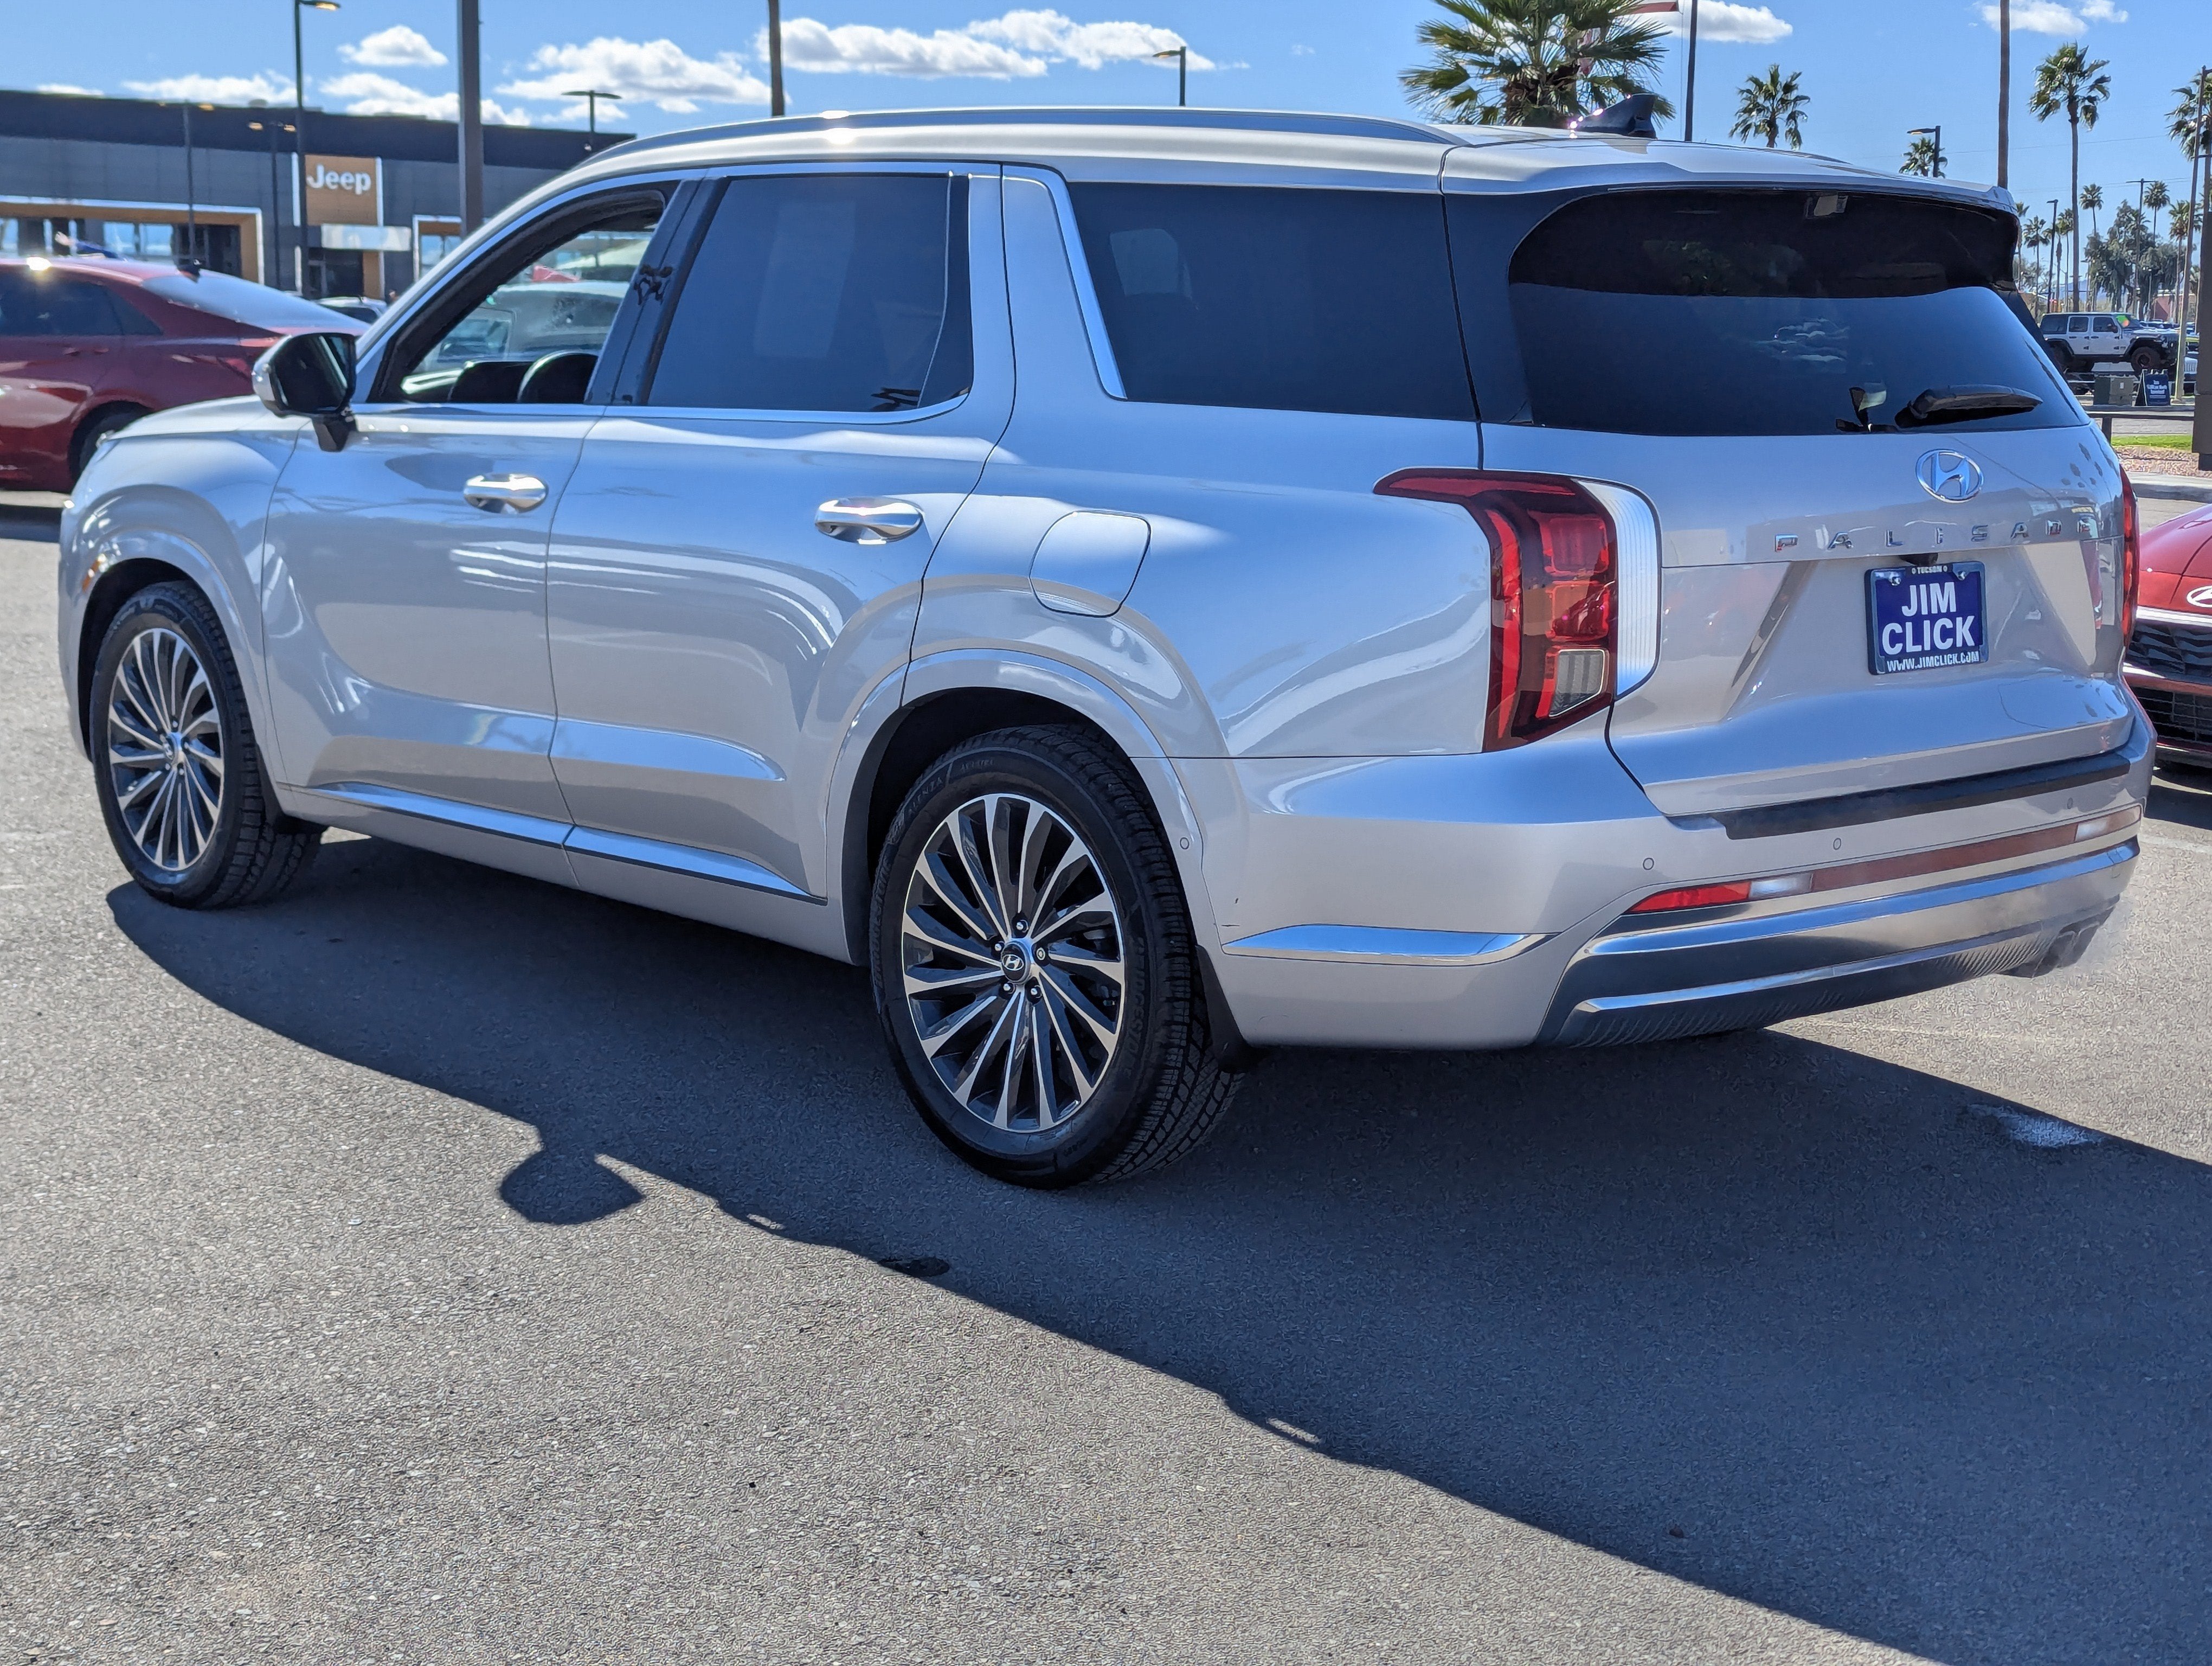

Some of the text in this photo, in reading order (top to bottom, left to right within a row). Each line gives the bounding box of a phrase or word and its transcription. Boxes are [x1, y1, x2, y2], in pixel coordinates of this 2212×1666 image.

[306, 164, 371, 195] Jeep
[1774, 519, 2090, 552] PALISADE
[1901, 581, 1957, 617] JIM
[1882, 616, 1975, 655] CLICK
[1887, 651, 1980, 672] WWW.JIMCLICK.COM
